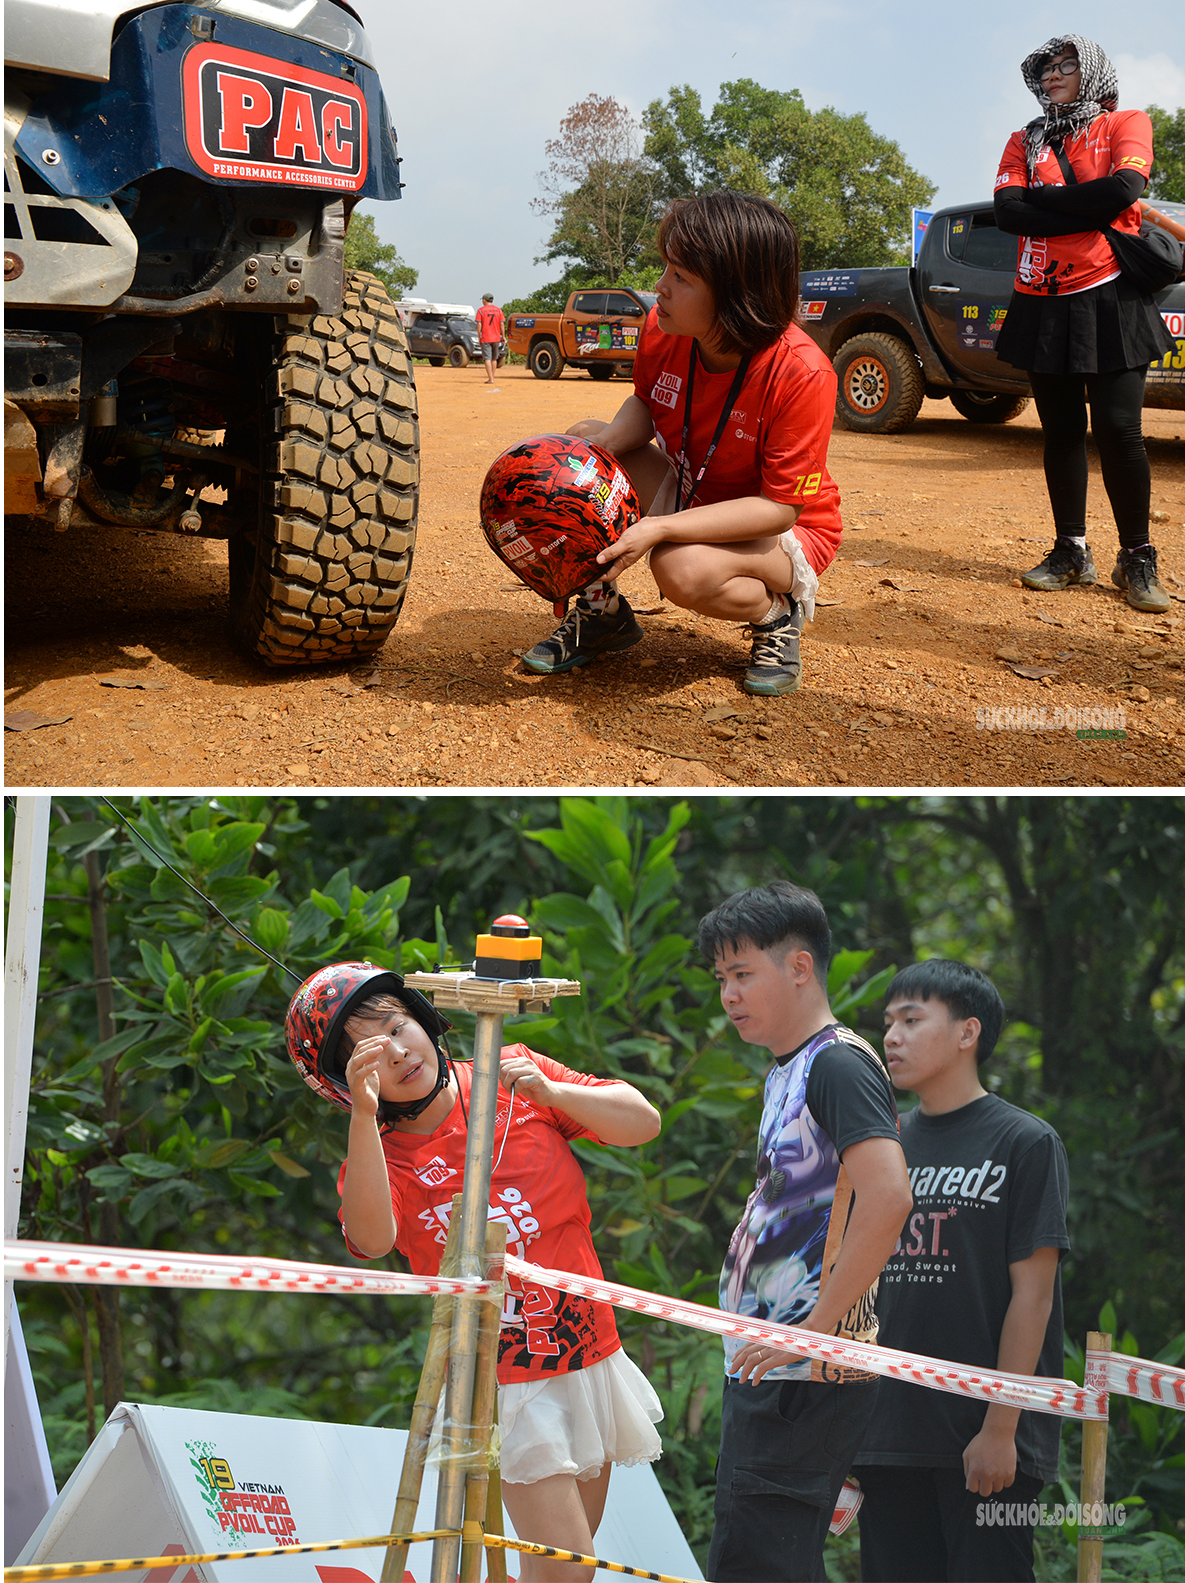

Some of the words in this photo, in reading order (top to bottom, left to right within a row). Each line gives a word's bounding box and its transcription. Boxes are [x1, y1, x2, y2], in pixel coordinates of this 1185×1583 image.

[217, 71, 353, 169] PAC
[213, 163, 283, 180] PERFORMANCE
[285, 171, 333, 186] ACCESSORIES
[334, 178, 356, 189] CENTER
[953, 224, 964, 234] 113
[487, 313, 495, 326] 7
[962, 305, 979, 319] 113
[624, 335, 636, 346] 101
[1150, 339, 1185, 369] 13
[659, 372, 679, 390] VOIL
[655, 387, 674, 405] 109
[595, 482, 611, 504] 19
[793, 472, 822, 496] 19
[502, 539, 531, 559] PVOIL
[425, 1166, 451, 1184] 109
[906, 1160, 1007, 1203] uared2
[937, 1198, 986, 1210] exclusive
[915, 1261, 957, 1272] Sweat
[907, 1273, 943, 1283] Tears
[198, 1457, 236, 1490] 19
[237, 1481, 285, 1495] VIETNAM
[218, 1491, 292, 1515] OFFROAD
[217, 1512, 266, 1534] PVOIL
[263, 1515, 297, 1536] CUP
